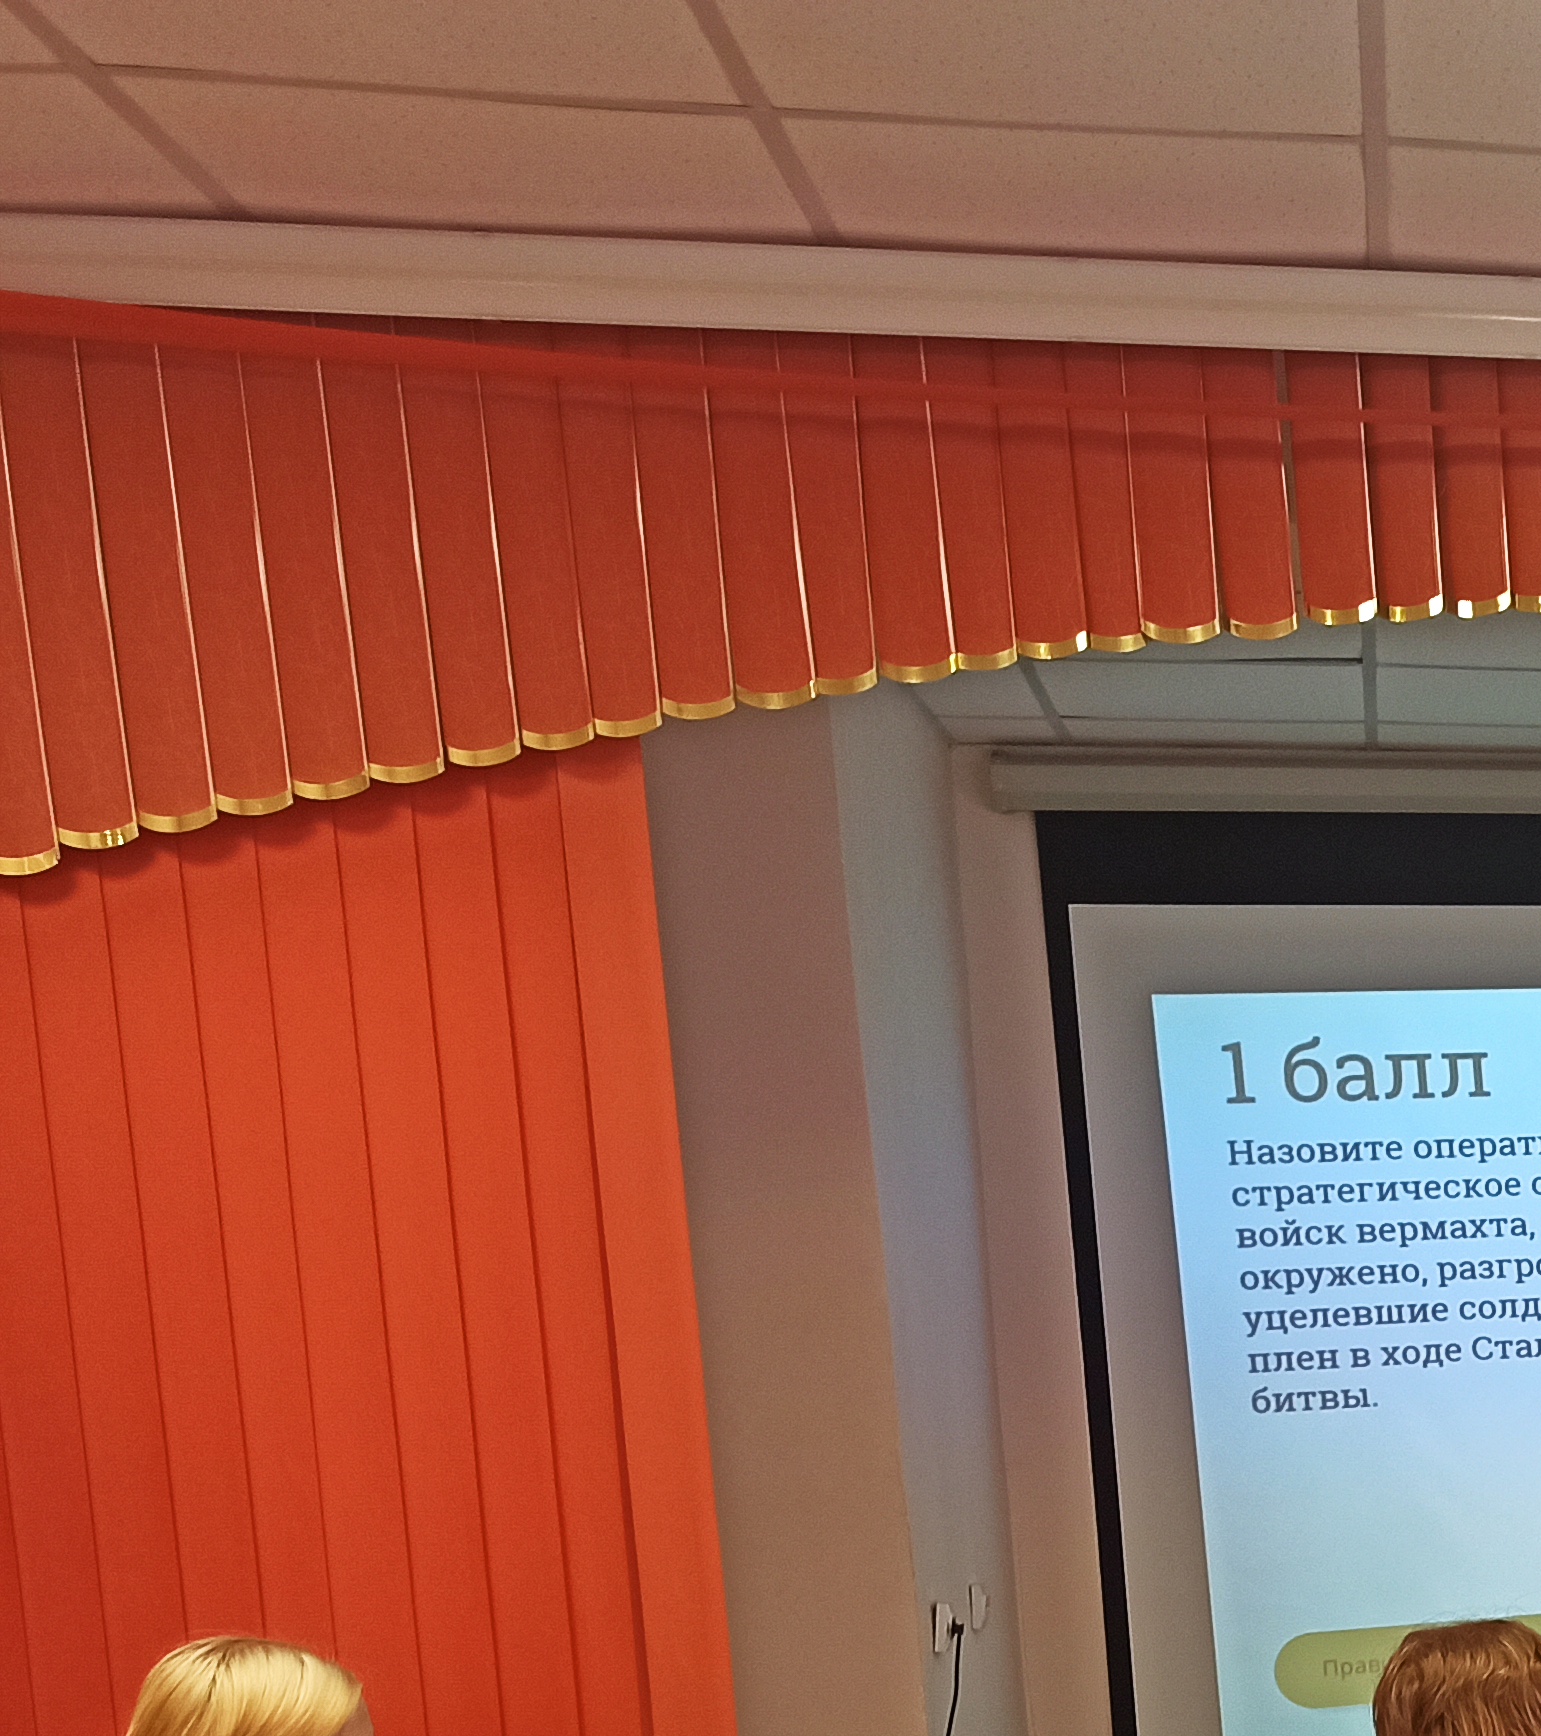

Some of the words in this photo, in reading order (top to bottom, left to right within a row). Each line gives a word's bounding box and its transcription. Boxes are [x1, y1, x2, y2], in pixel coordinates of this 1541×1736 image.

[1220, 1040, 1257, 1105] 1
[1283, 1035, 1492, 1104] балл
[1226, 1139, 1404, 1167] Назовите
[1231, 1176, 1522, 1213] стратегическое
[1235, 1218, 1348, 1249] войск
[1355, 1216, 1536, 1249] вермахта,
[1239, 1263, 1429, 1296] окружено,
[1241, 1302, 1449, 1339] уцелевшие
[1247, 1348, 1341, 1374] плен
[1348, 1347, 1372, 1369] в
[1379, 1342, 1462, 1369] ходе
[1251, 1385, 1379, 1415] битвы.
[1322, 1659, 1387, 1680] Прав
